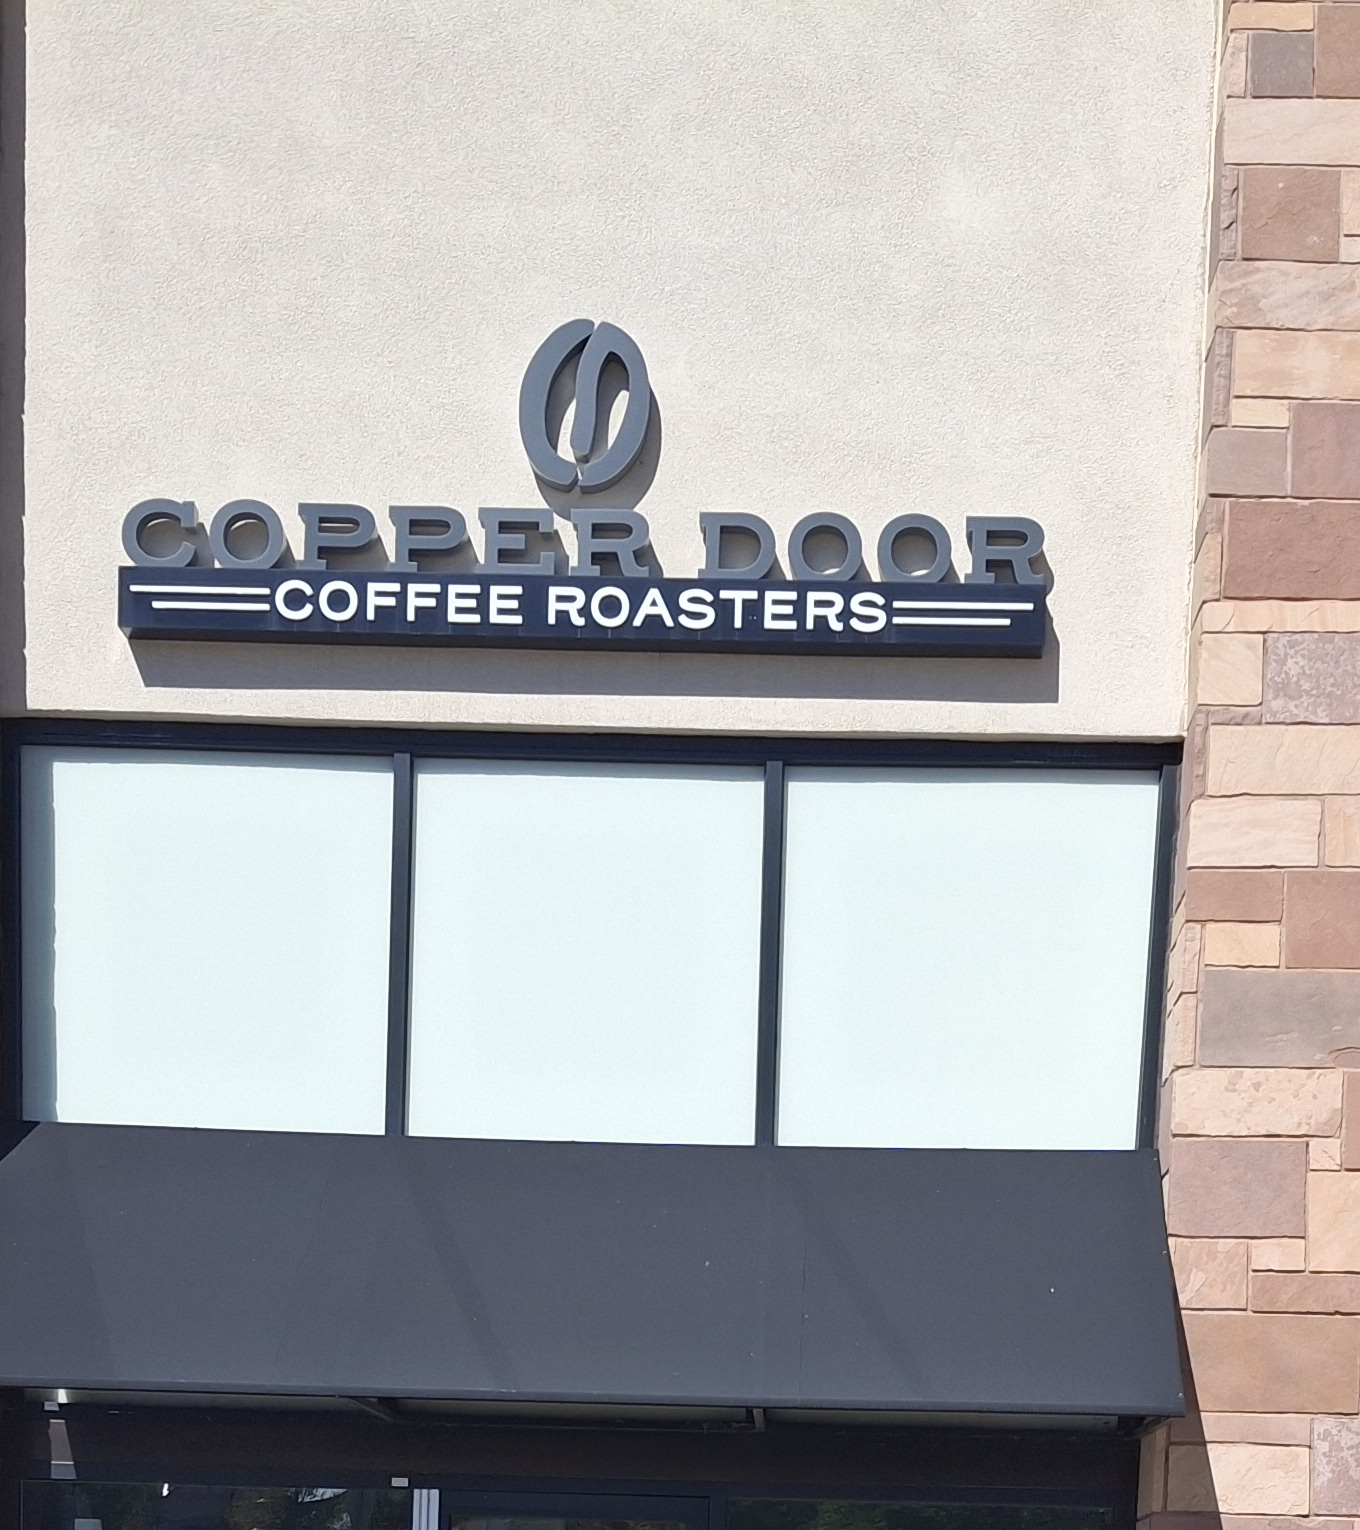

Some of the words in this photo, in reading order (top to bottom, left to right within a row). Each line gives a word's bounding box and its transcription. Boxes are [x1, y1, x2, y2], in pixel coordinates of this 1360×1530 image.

[121, 498, 651, 577] COPPER
[698, 510, 1045, 584] DOOR
[275, 579, 524, 626] COFFEE
[546, 585, 889, 634] ROASTERS
